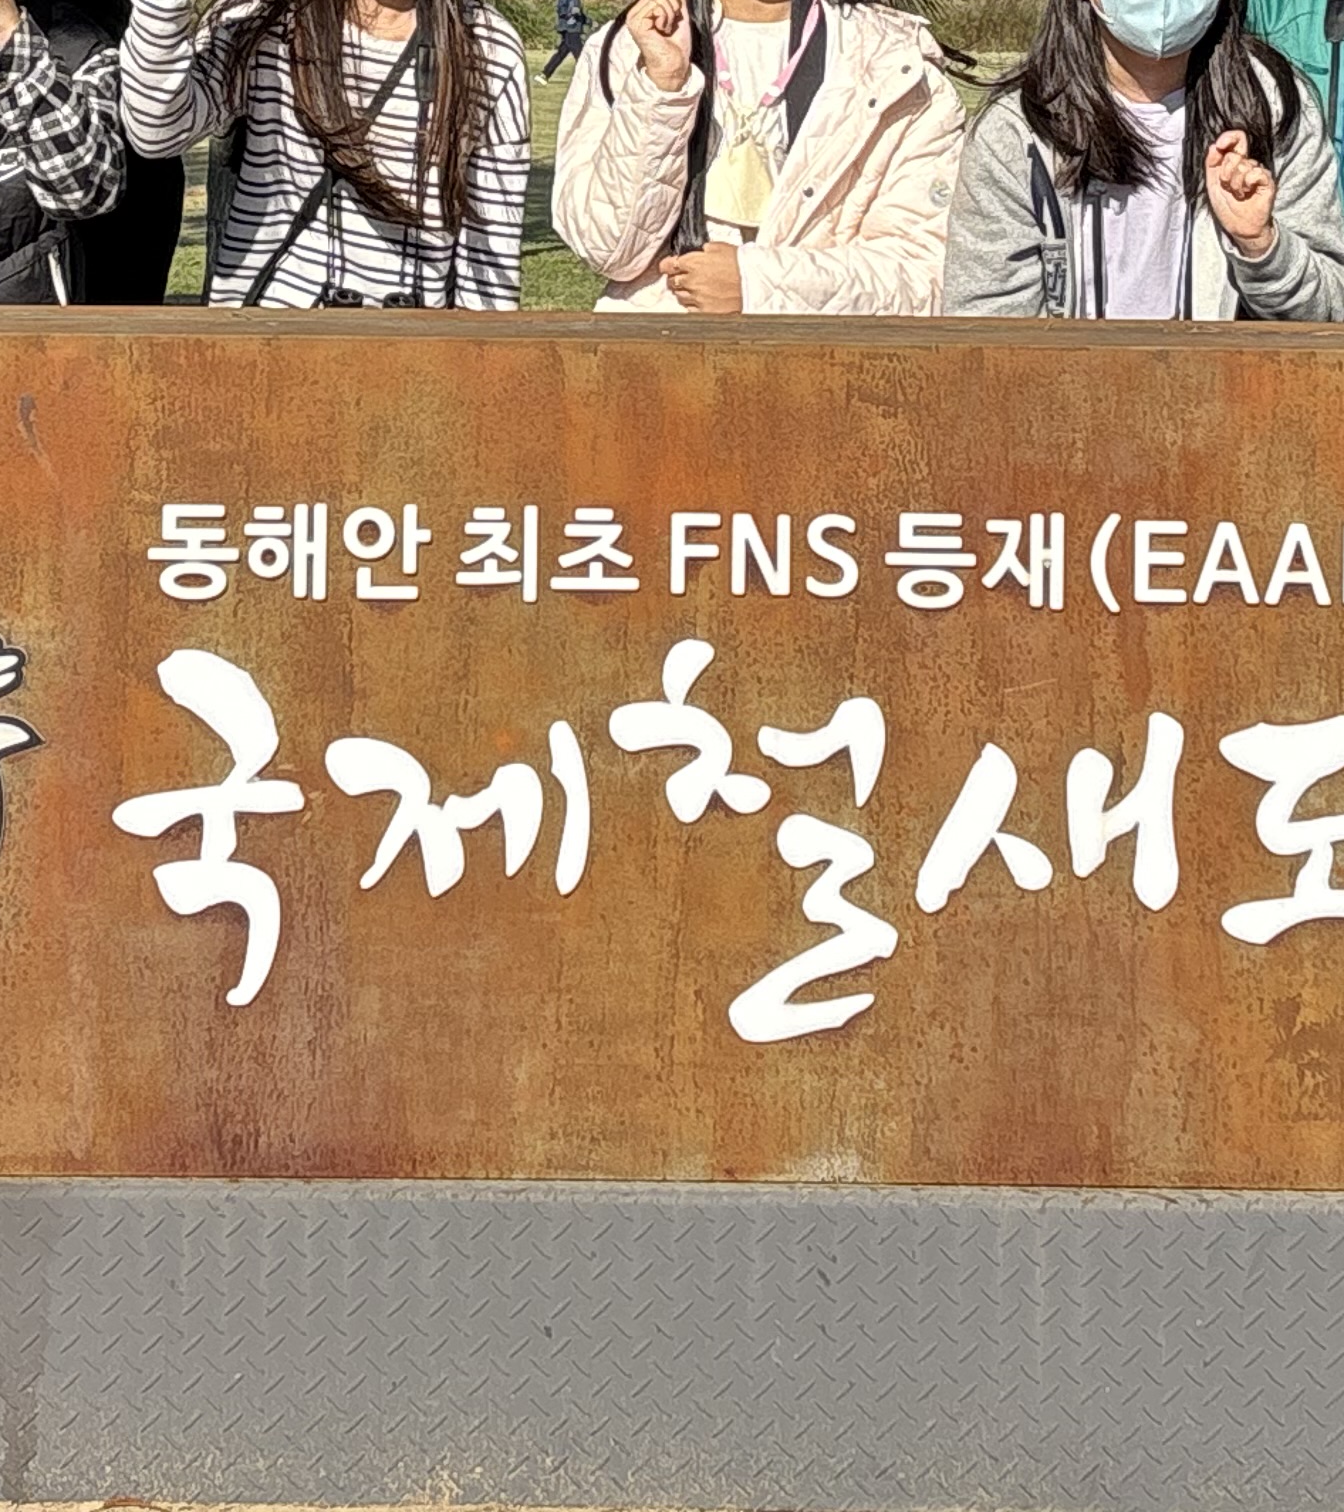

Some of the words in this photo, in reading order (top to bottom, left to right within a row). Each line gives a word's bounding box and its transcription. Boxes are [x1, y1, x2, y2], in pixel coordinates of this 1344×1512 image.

[147, 502, 432, 600] 동해안
[455, 504, 640, 603] 최초
[670, 512, 859, 597] FNS
[884, 512, 1065, 610] 등재
